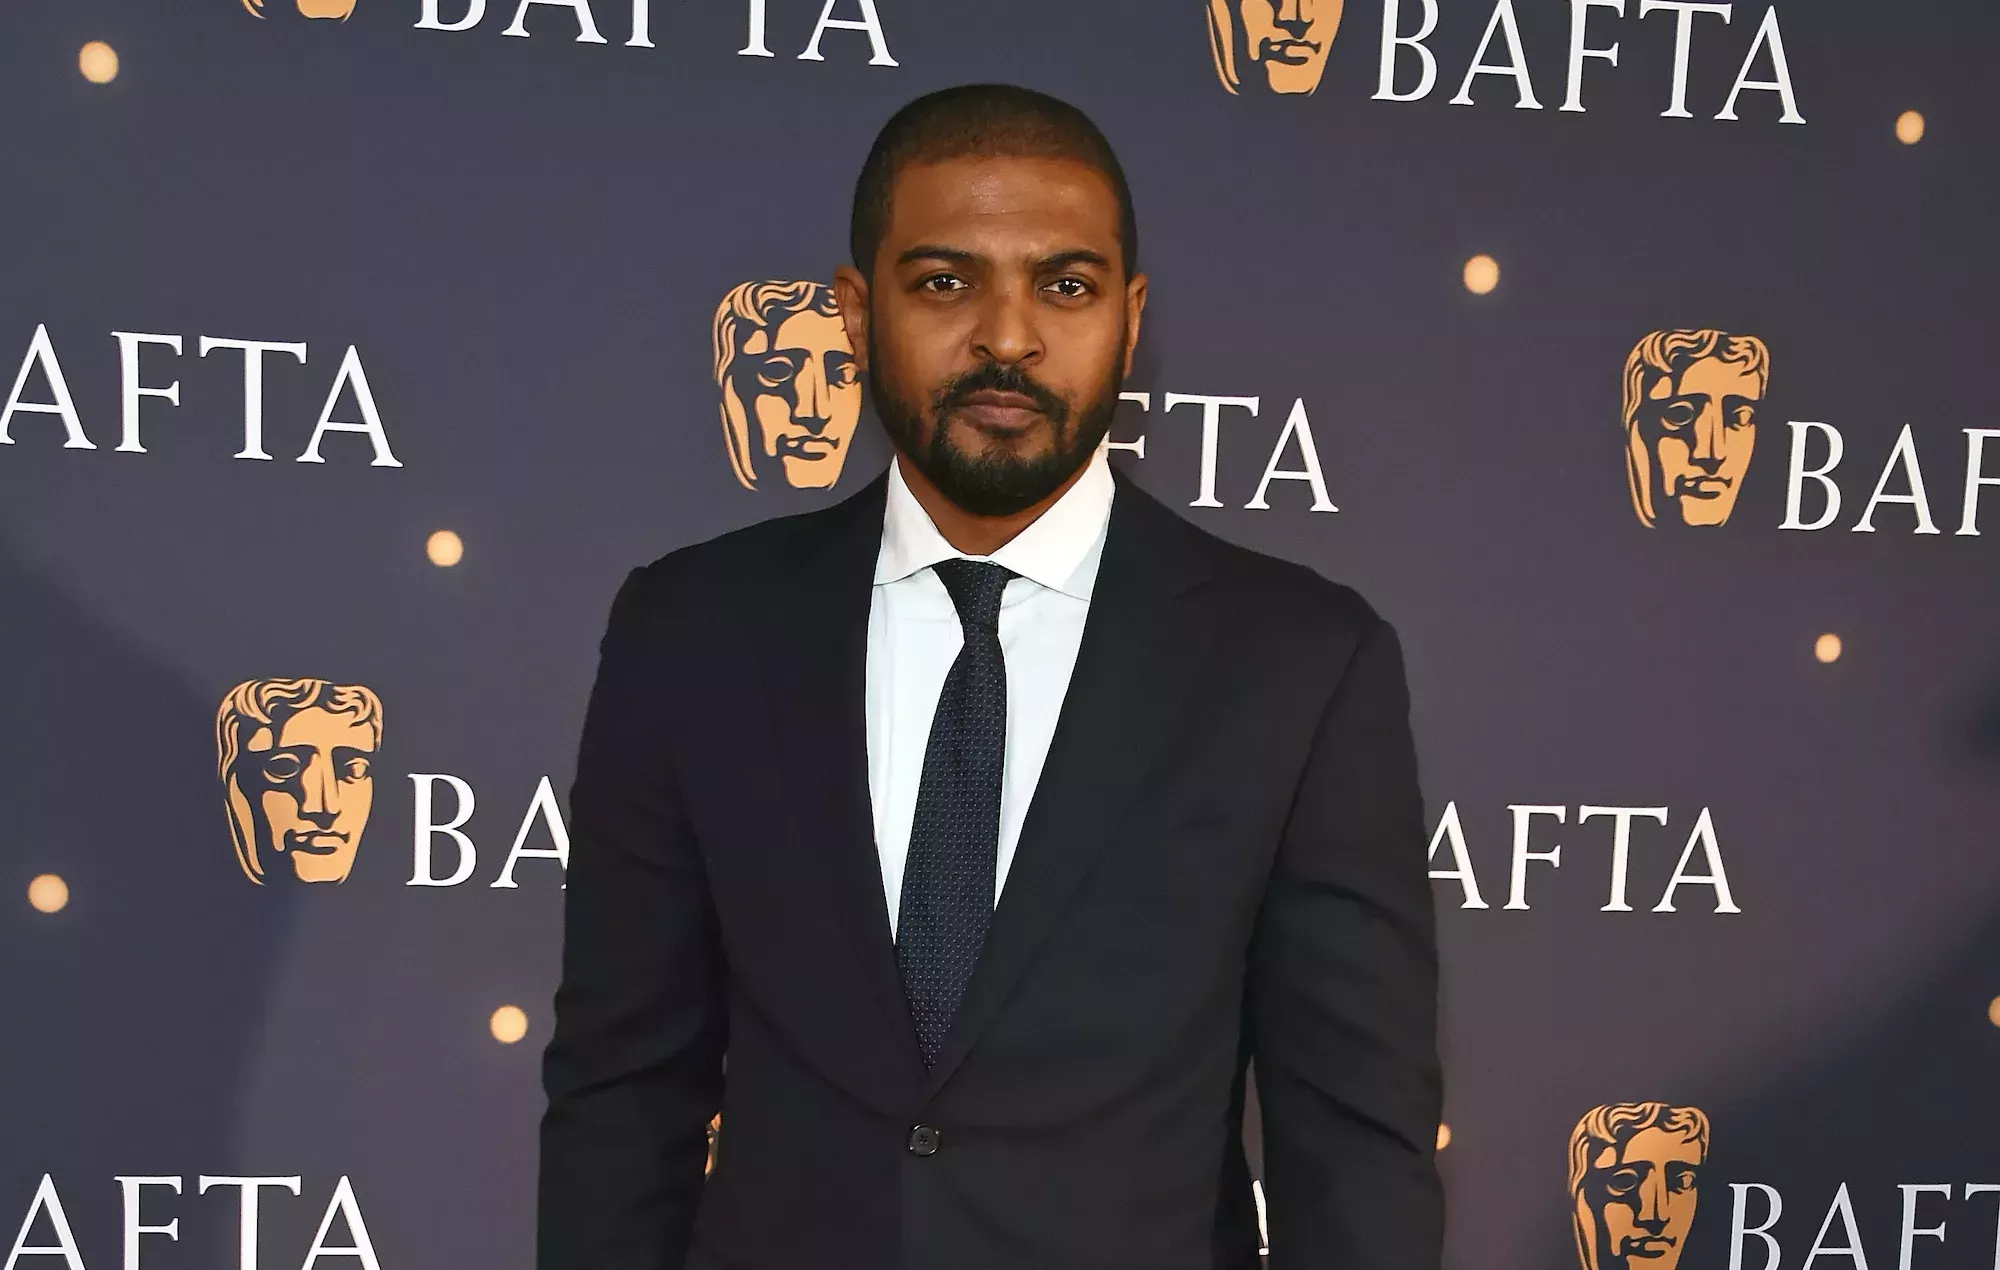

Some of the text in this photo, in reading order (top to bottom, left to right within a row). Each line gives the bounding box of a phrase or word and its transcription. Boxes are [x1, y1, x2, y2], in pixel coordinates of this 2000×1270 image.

[1370, 0, 1807, 125] BAFTA
[0, 323, 404, 468] AFTA
[1777, 420, 2000, 536] BAF
[405, 773, 570, 889] BA
[1427, 800, 1742, 914] AFTA
[3, 1172, 381, 1270] AFTA
